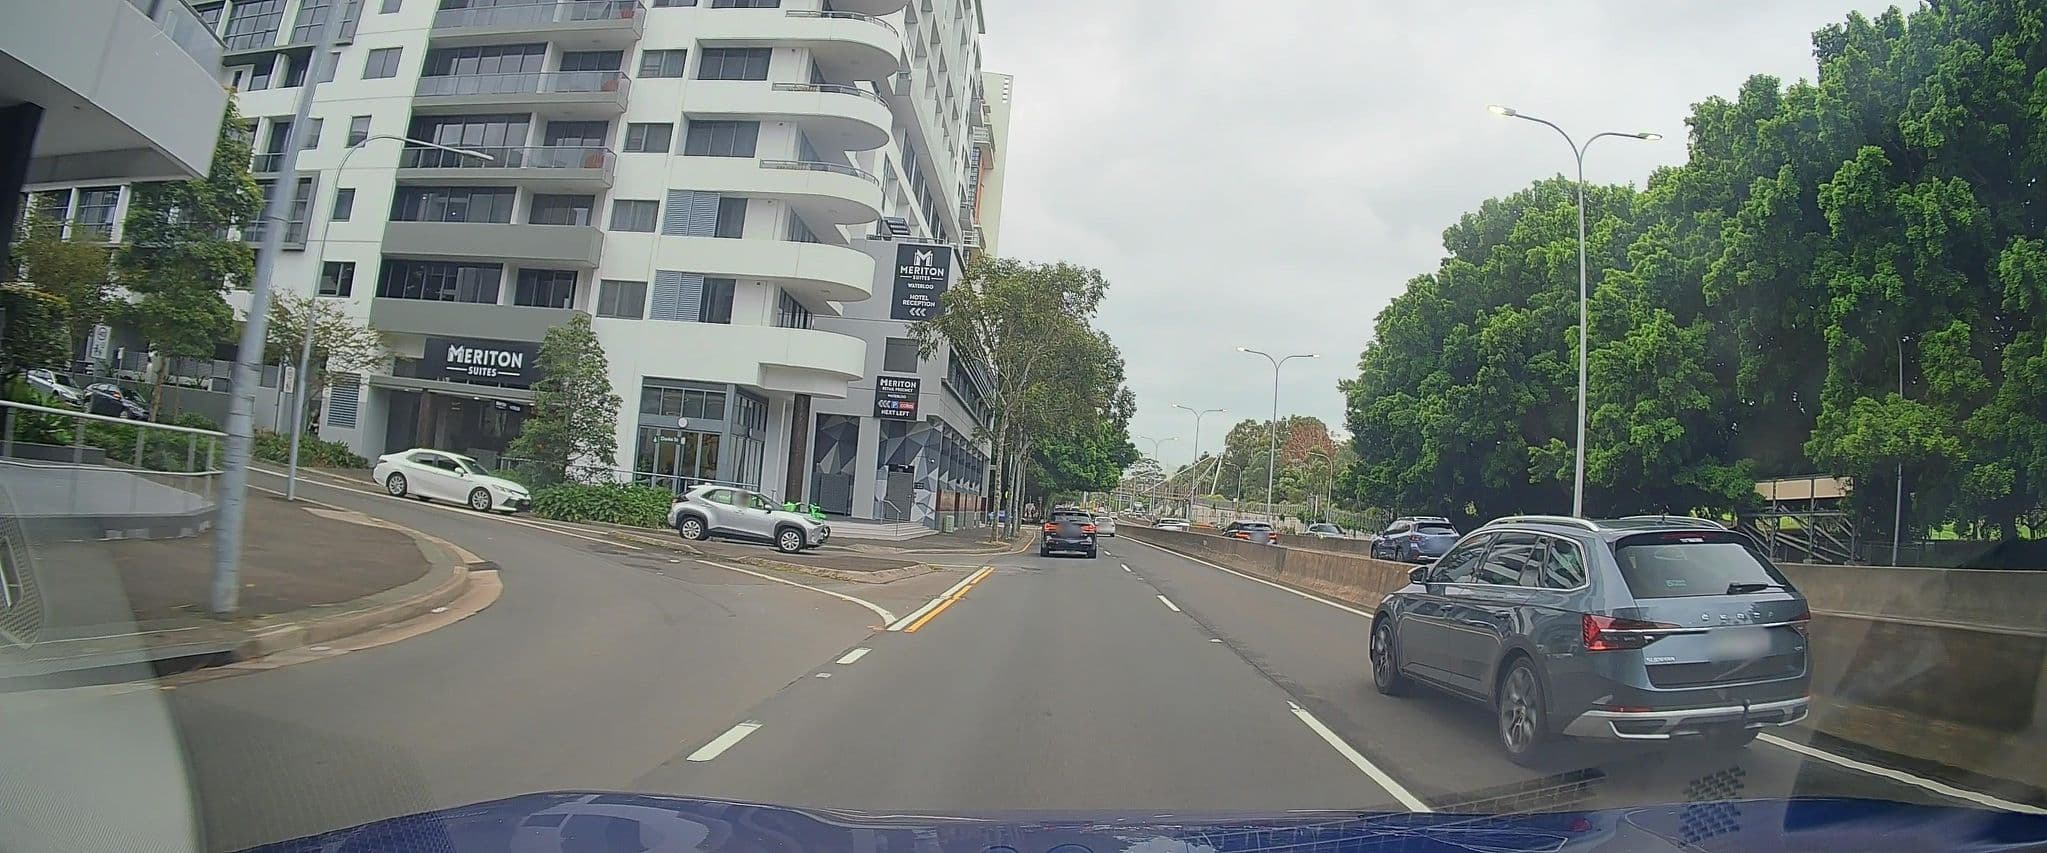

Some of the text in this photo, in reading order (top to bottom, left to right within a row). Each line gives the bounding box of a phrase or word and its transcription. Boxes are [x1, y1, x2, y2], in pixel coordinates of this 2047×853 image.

[900, 265, 945, 277] MERITON
[447, 344, 523, 369] MERITON
[468, 366, 497, 377] SUITES
[880, 378, 916, 388] MERITON
